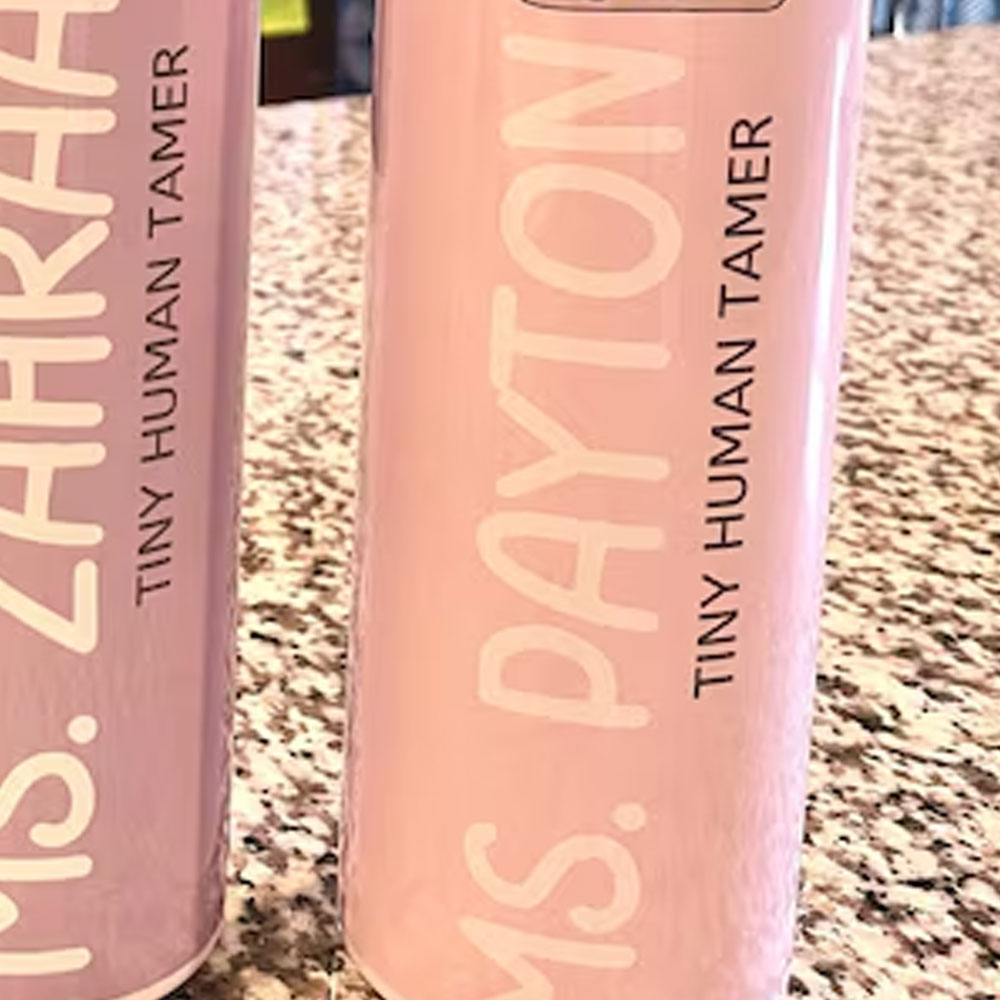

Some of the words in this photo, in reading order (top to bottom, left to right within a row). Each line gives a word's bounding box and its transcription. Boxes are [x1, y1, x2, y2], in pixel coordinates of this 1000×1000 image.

[147, 43, 190, 239] TAMER
[717, 114, 774, 317] TAMER
[141, 256, 183, 463] HUMAN
[476, 33, 687, 729] PAYTON
[703, 338, 758, 552] HUMAN
[136, 484, 177, 605] TINY
[693, 577, 741, 700] TINY
